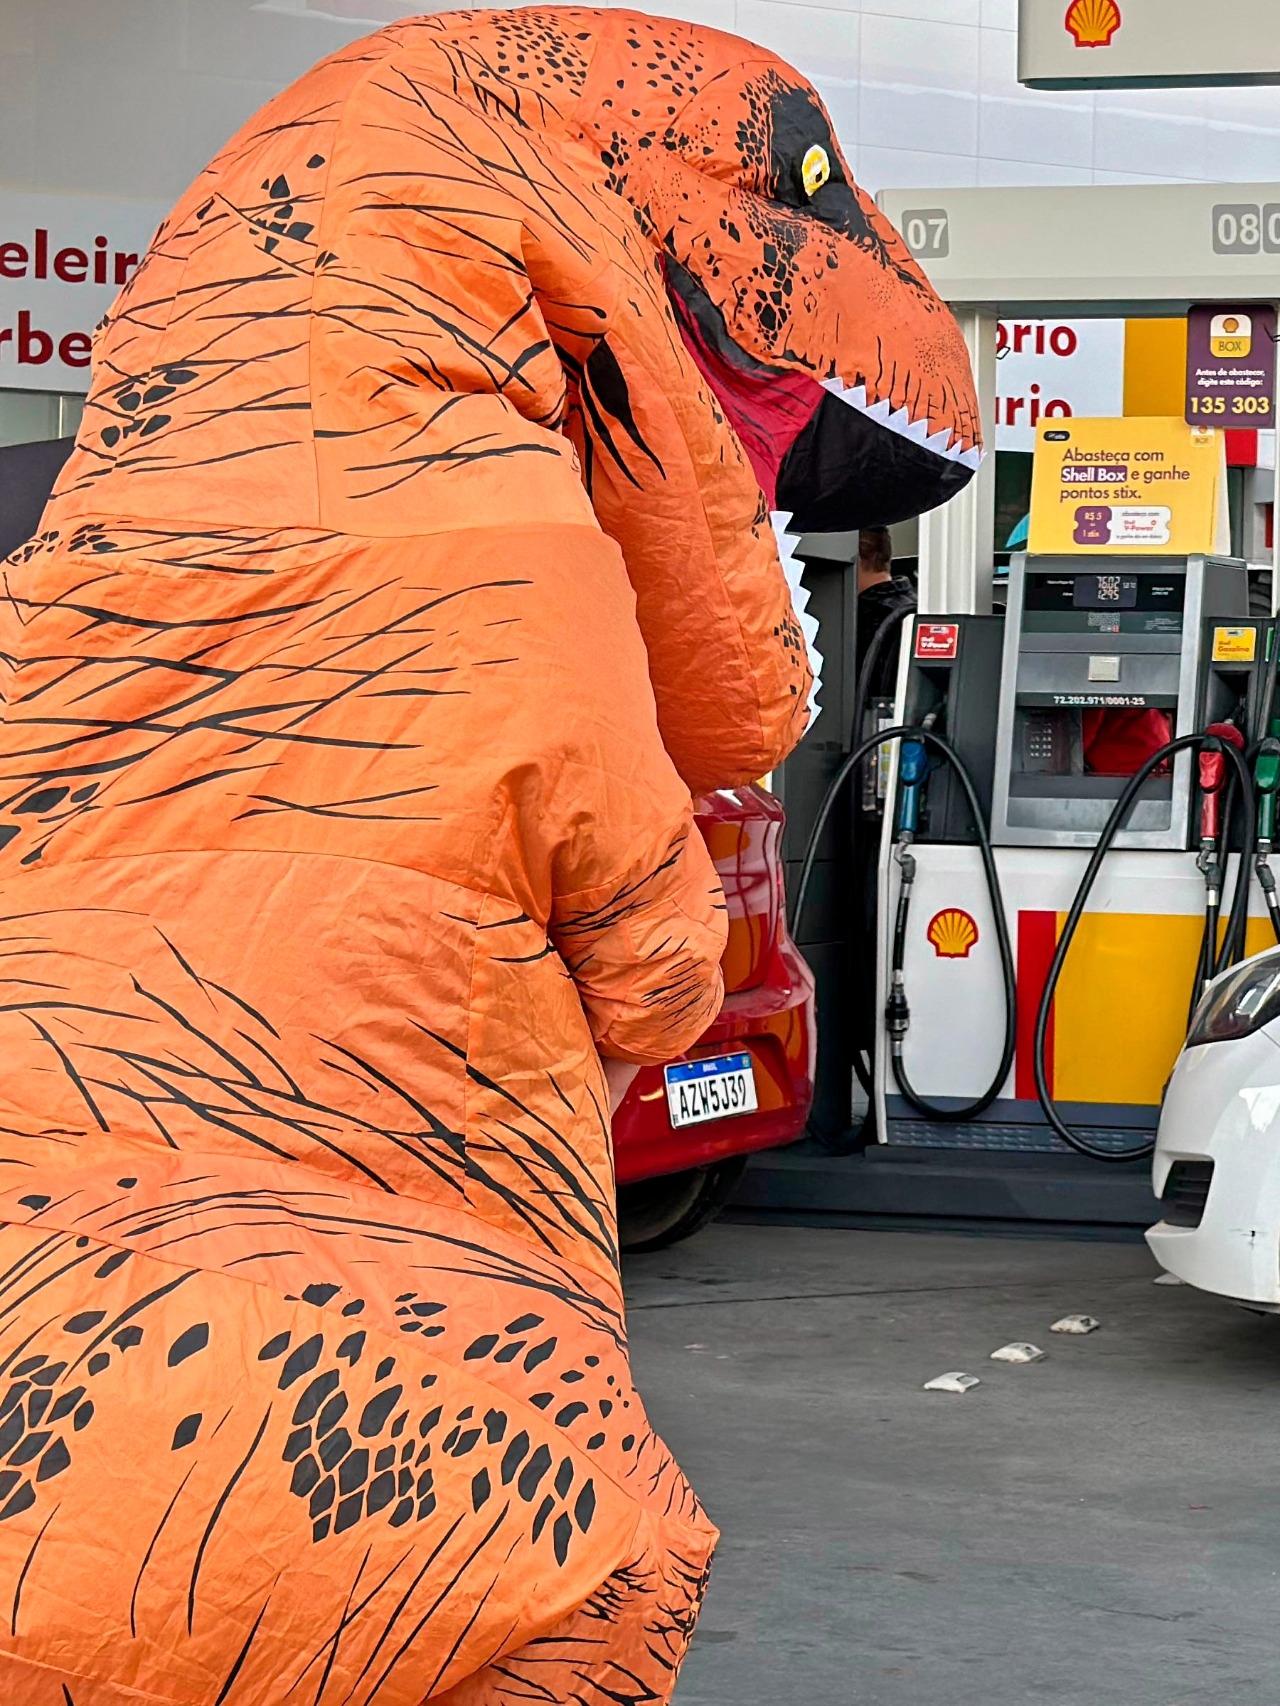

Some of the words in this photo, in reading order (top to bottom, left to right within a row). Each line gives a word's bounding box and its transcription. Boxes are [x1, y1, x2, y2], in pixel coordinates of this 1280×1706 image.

[907, 219, 947, 250] 07
[1218, 213, 1260, 246] 08
[1218, 341, 1242, 352] BOX
[1217, 367, 1227, 376] de
[1191, 396, 1226, 414] 135
[1232, 396, 1270, 414] 303
[1062, 448, 1130, 464] Abasteça
[1134, 451, 1164, 462] com
[1061, 468, 1095, 482] Shell
[1097, 468, 1126, 482] Box
[1131, 471, 1139, 480] e
[1143, 465, 1190, 484] ganhe
[1060, 486, 1110, 503] pontos
[1113, 485, 1142, 499] stix.
[679, 1074, 746, 1120] AZW5J39
